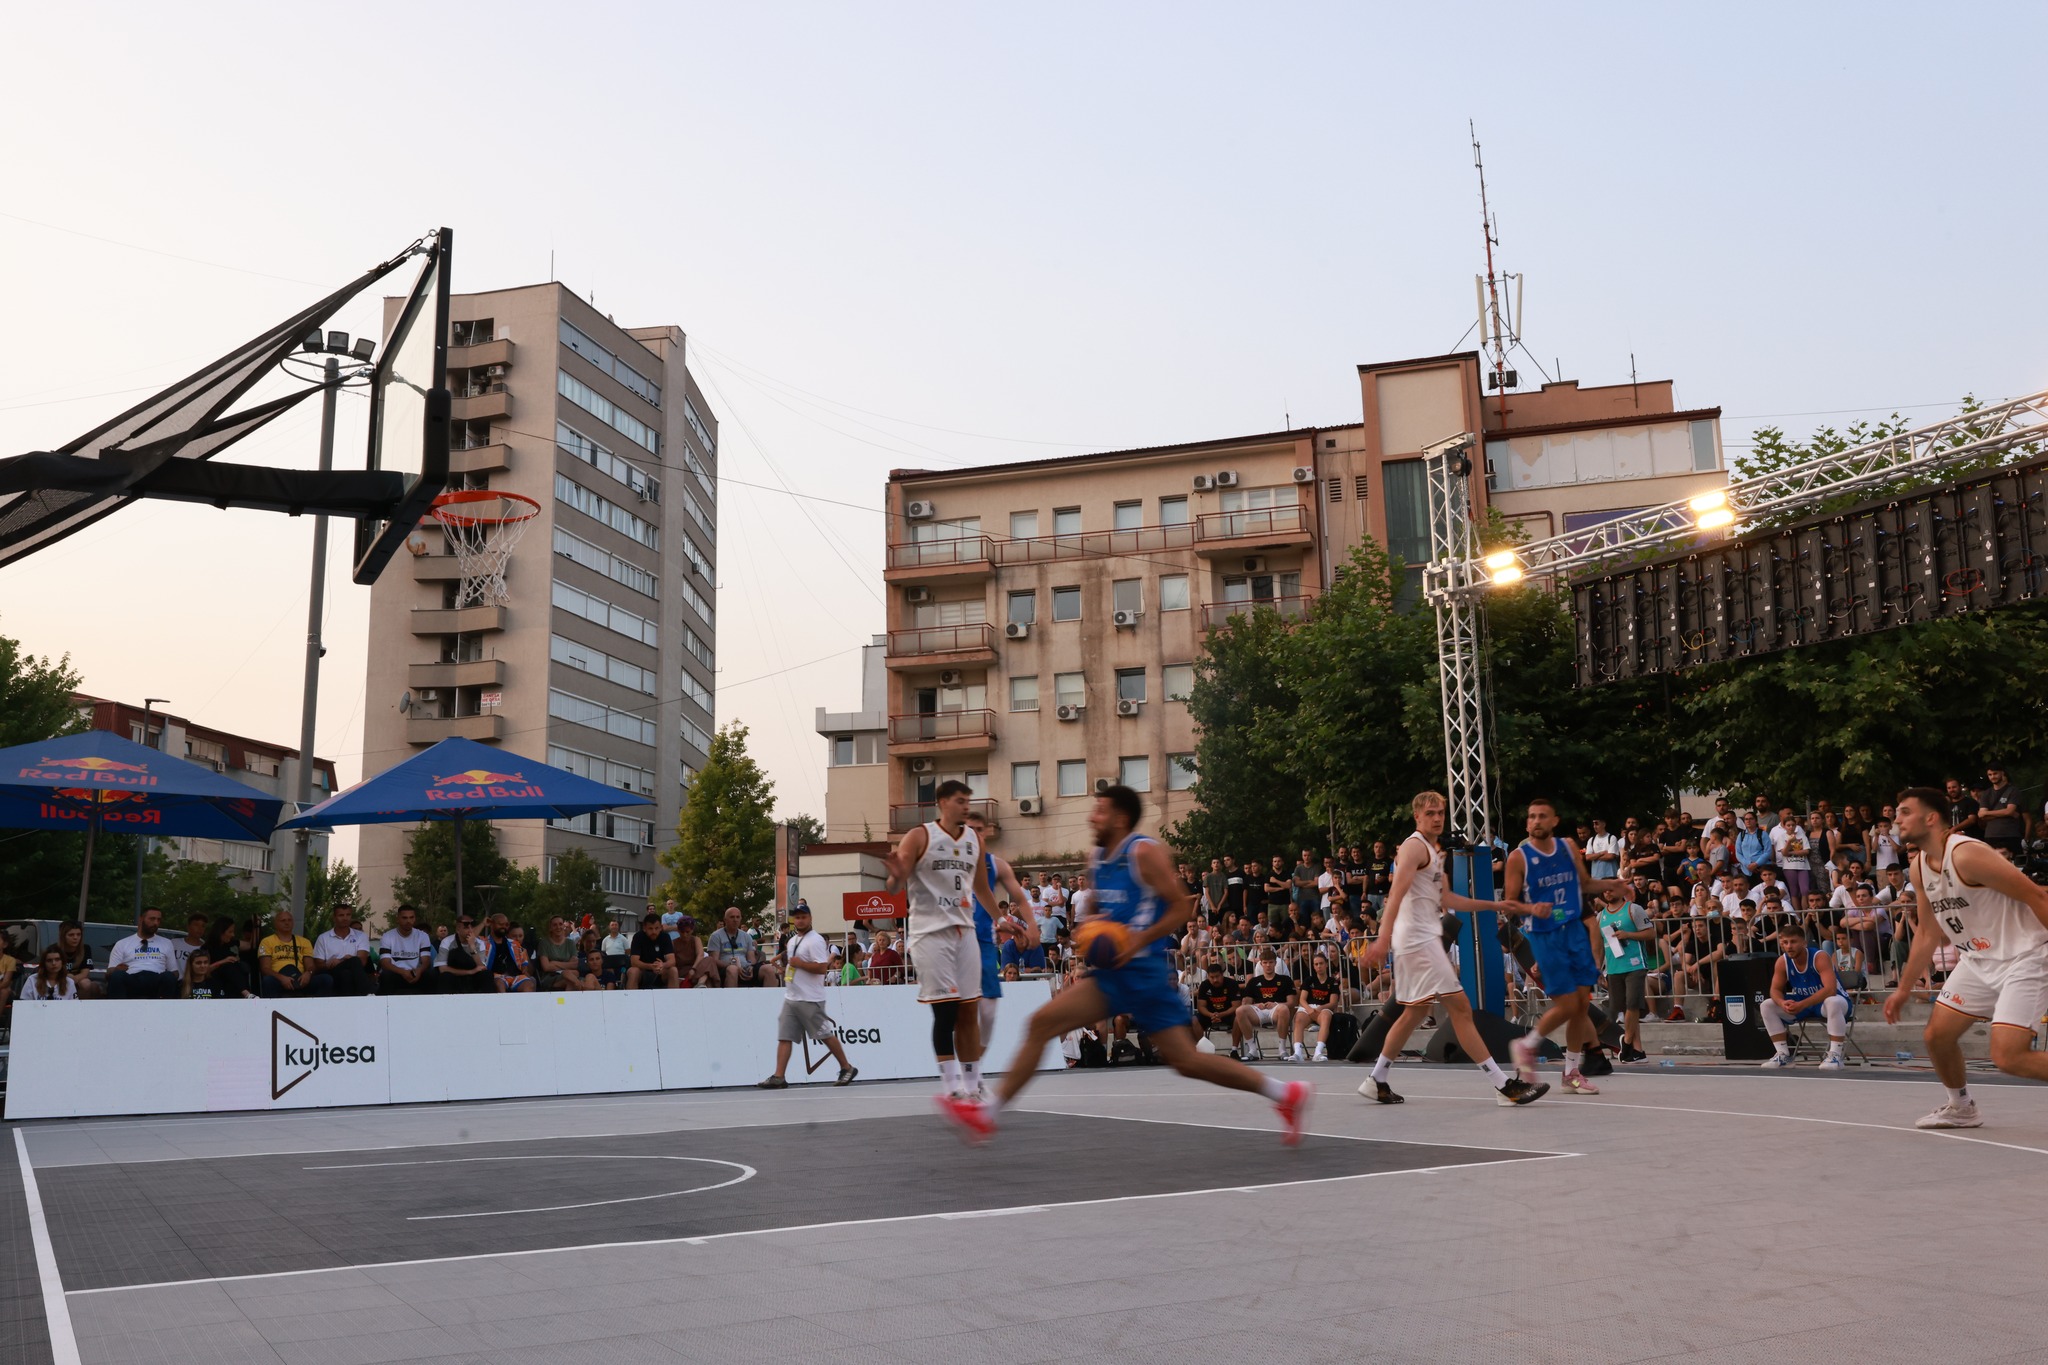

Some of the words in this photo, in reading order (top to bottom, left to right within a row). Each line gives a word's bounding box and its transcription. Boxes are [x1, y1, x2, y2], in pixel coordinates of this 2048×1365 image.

[18, 768, 89, 781] Red
[93, 771, 158, 786] Bull
[426, 786, 486, 801] Red
[488, 785, 545, 798] Bull
[1553, 888, 1568, 905] 12
[859, 906, 892, 914] vitaminka
[285, 1042, 376, 1072] kujtesa
